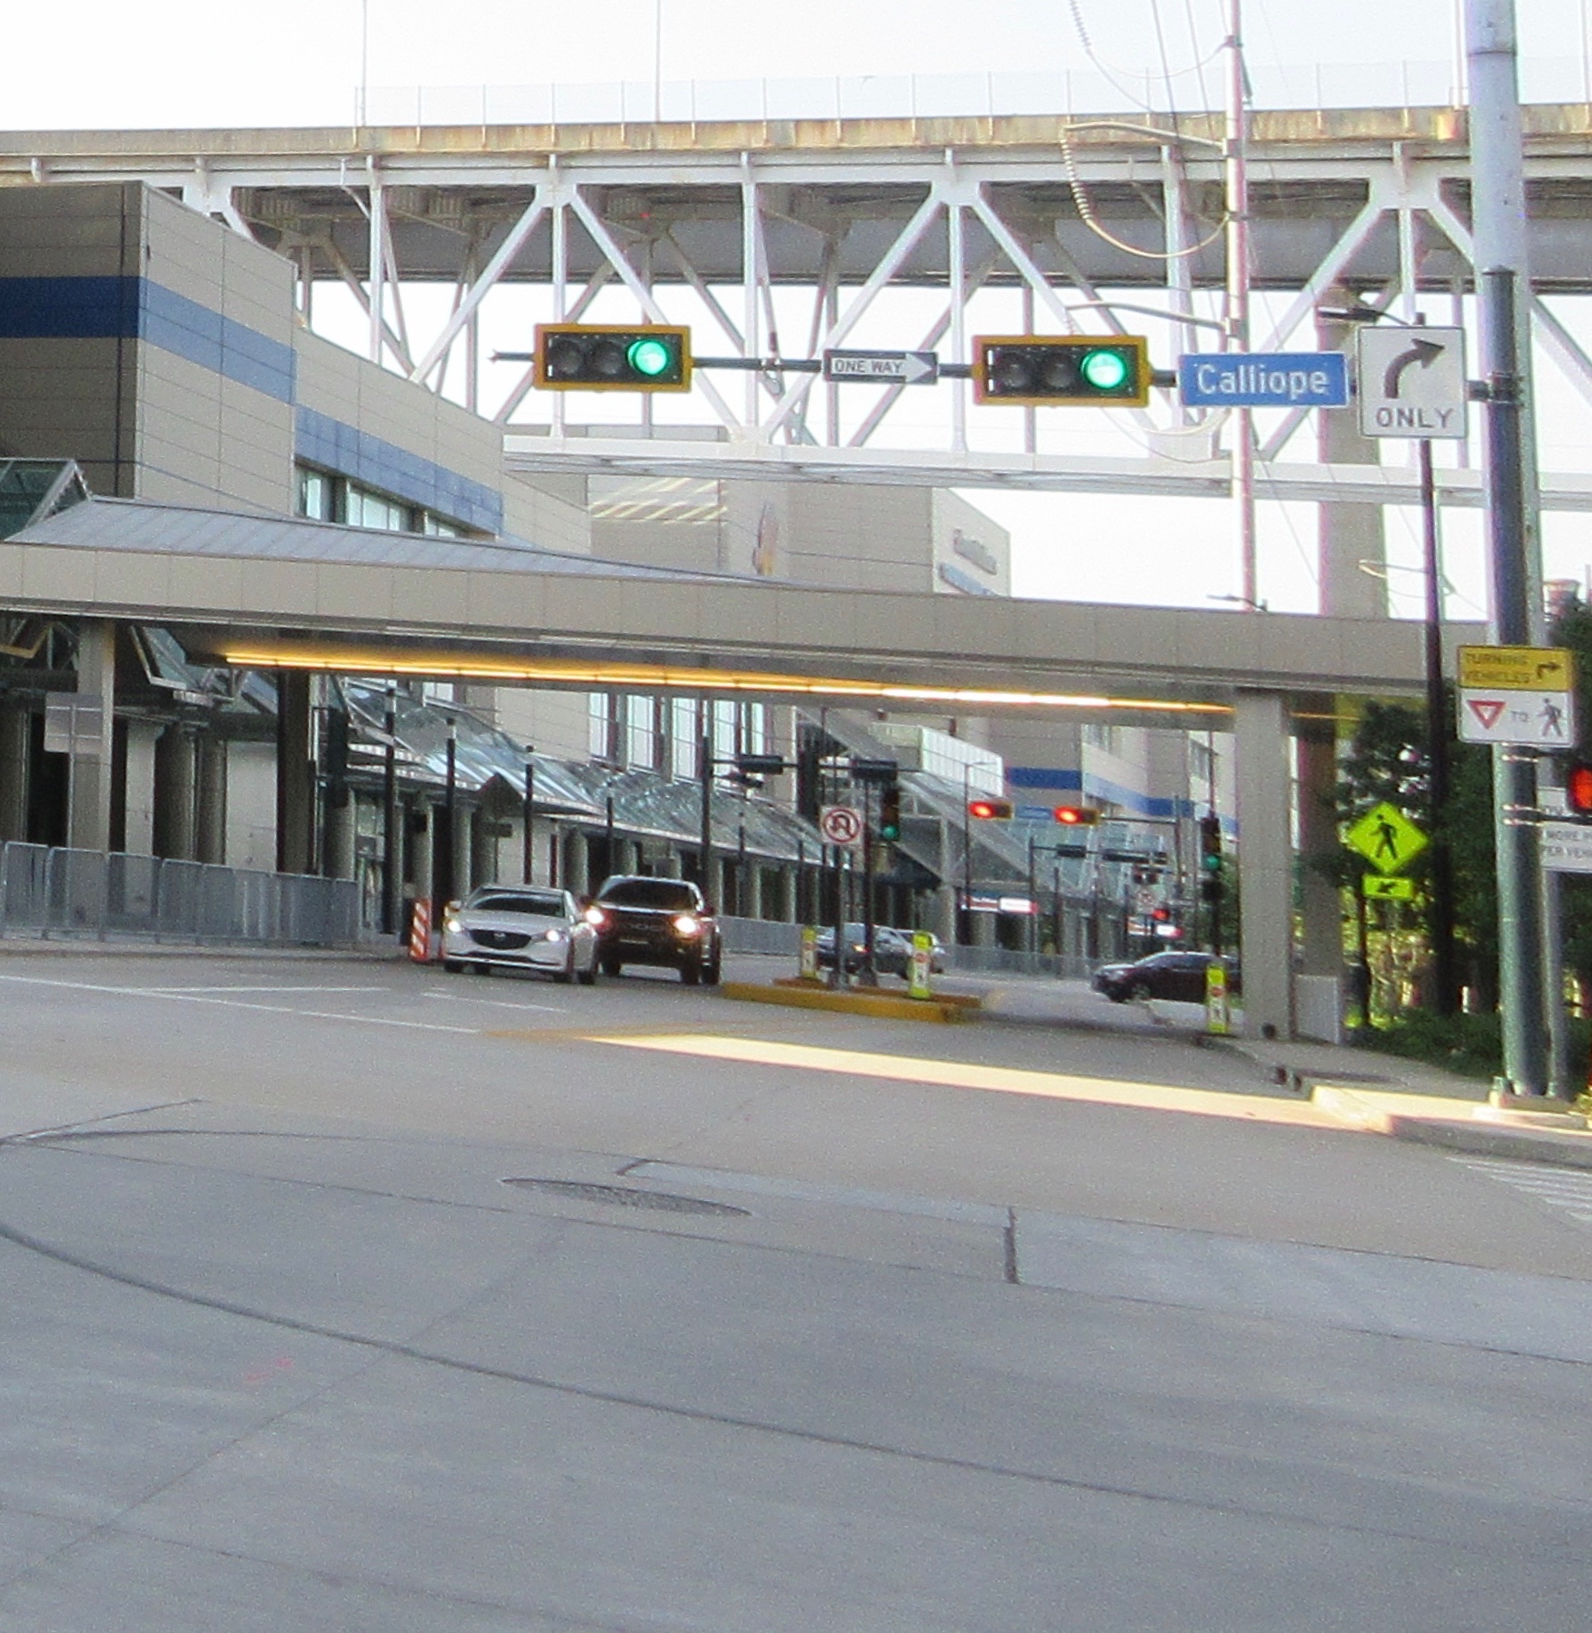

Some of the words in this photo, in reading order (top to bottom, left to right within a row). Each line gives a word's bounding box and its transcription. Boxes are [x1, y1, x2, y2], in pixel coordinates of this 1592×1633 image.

[835, 359, 865, 373] ONE
[871, 360, 904, 373] WAY
[1197, 364, 1329, 400] Calliope
[1376, 408, 1453, 428] ONLY
[1466, 652, 1529, 666] TURNING
[1465, 670, 1532, 684] VEHICLES
[1510, 710, 1529, 723] TO
